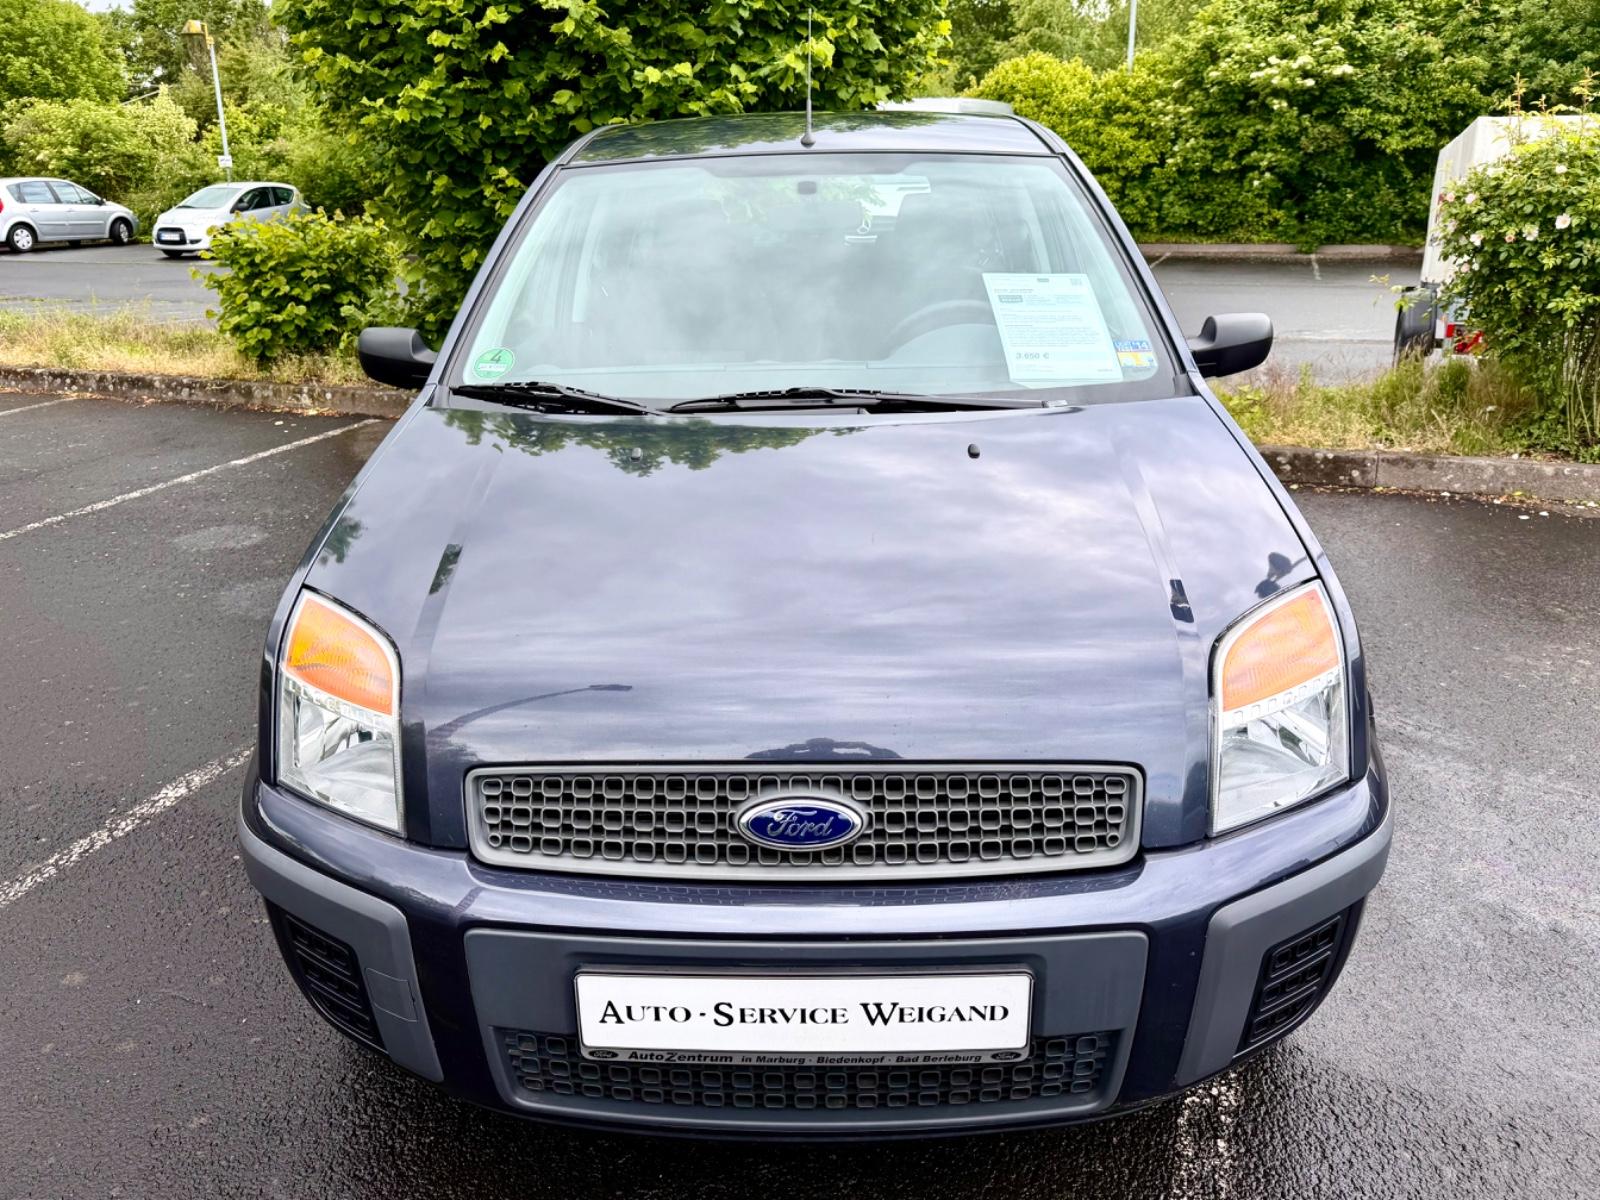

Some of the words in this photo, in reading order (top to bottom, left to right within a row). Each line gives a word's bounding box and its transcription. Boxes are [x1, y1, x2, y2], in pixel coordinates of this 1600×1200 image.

[490, 349, 503, 363] 4
[766, 808, 835, 837] Ford
[859, 1001, 1009, 1026] WEIGAND
[627, 1051, 734, 1063] AutoZentrum
[741, 1055, 752, 1063] in
[755, 1055, 806, 1065] Marburg
[816, 1055, 885, 1065] Biedenkopf
[895, 1055, 919, 1063] Bad
[923, 1054, 983, 1064] Berleburg
